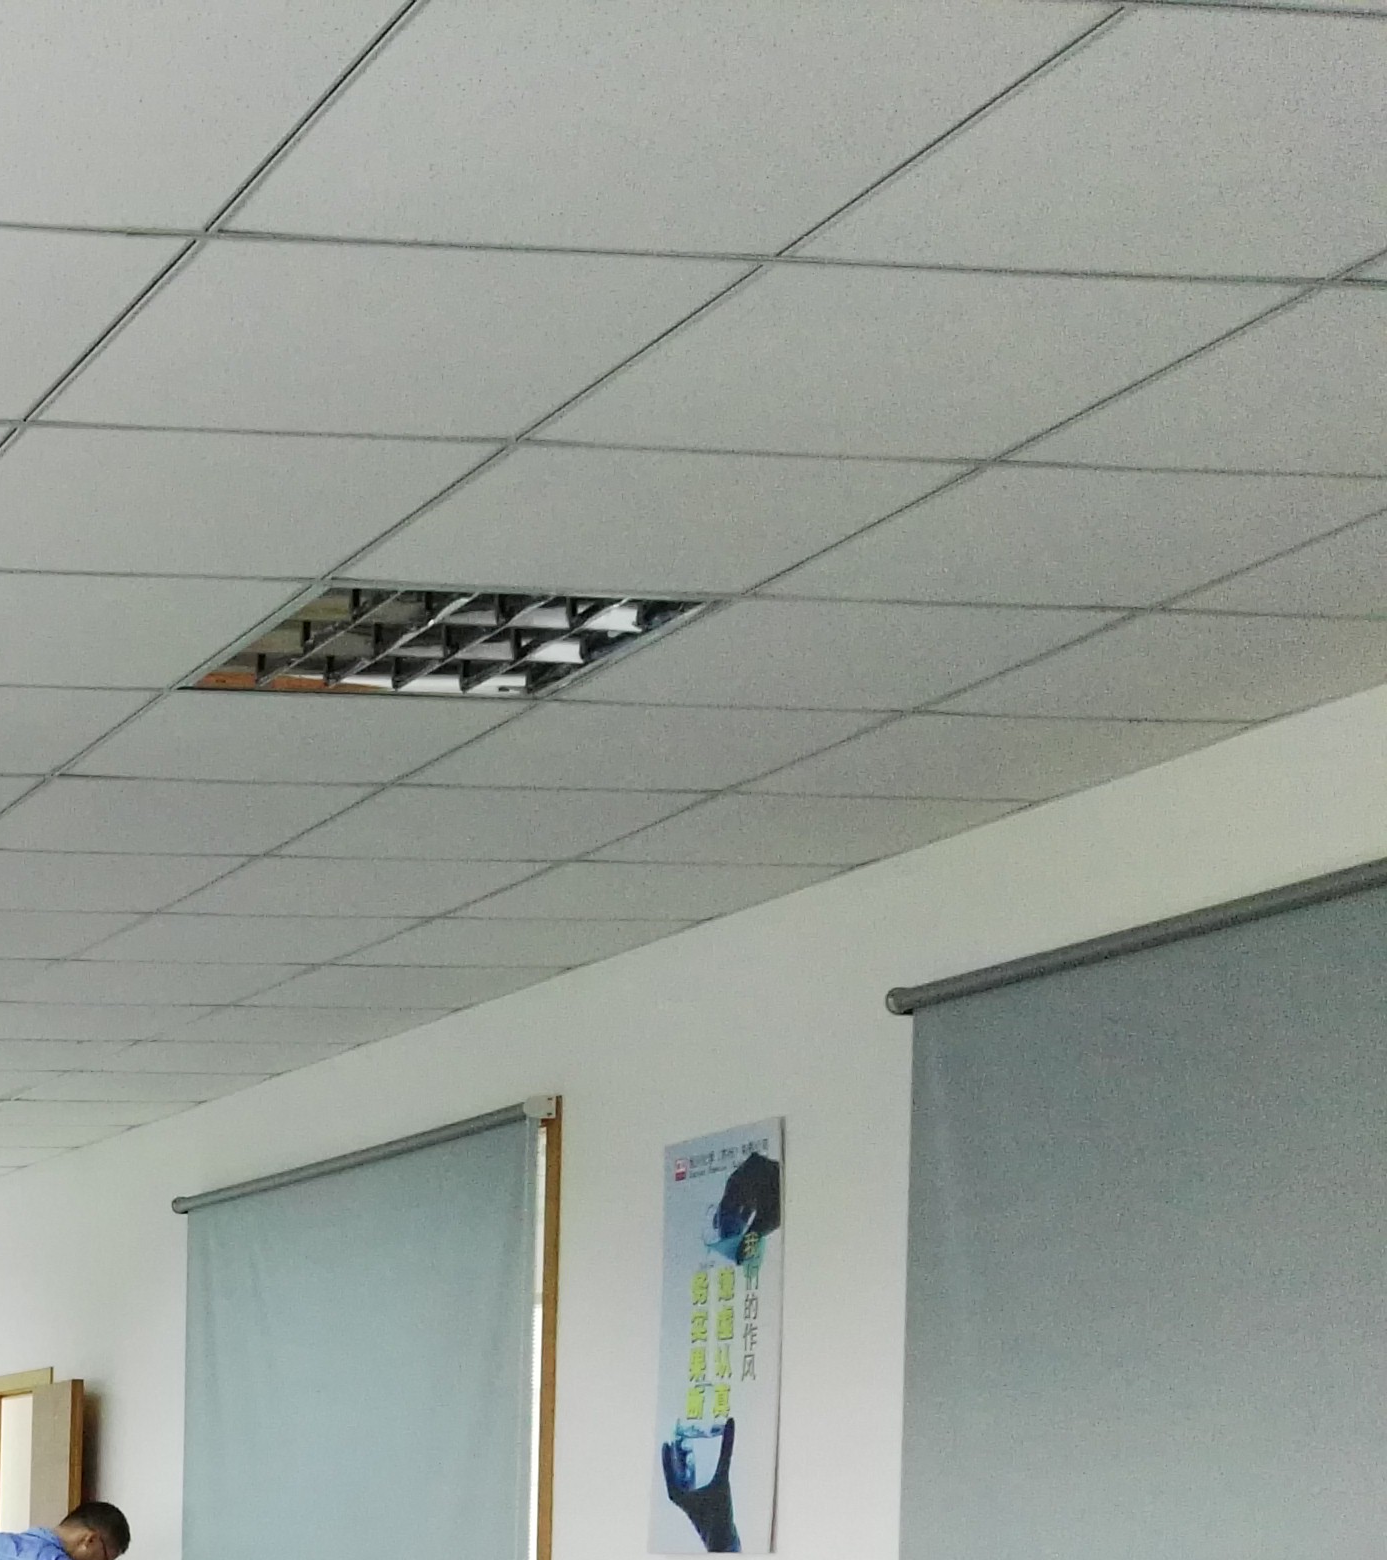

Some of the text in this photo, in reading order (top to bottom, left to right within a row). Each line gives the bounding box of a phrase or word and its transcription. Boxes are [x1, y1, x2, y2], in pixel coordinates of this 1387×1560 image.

[741, 1231, 760, 1382] 我们的作风
